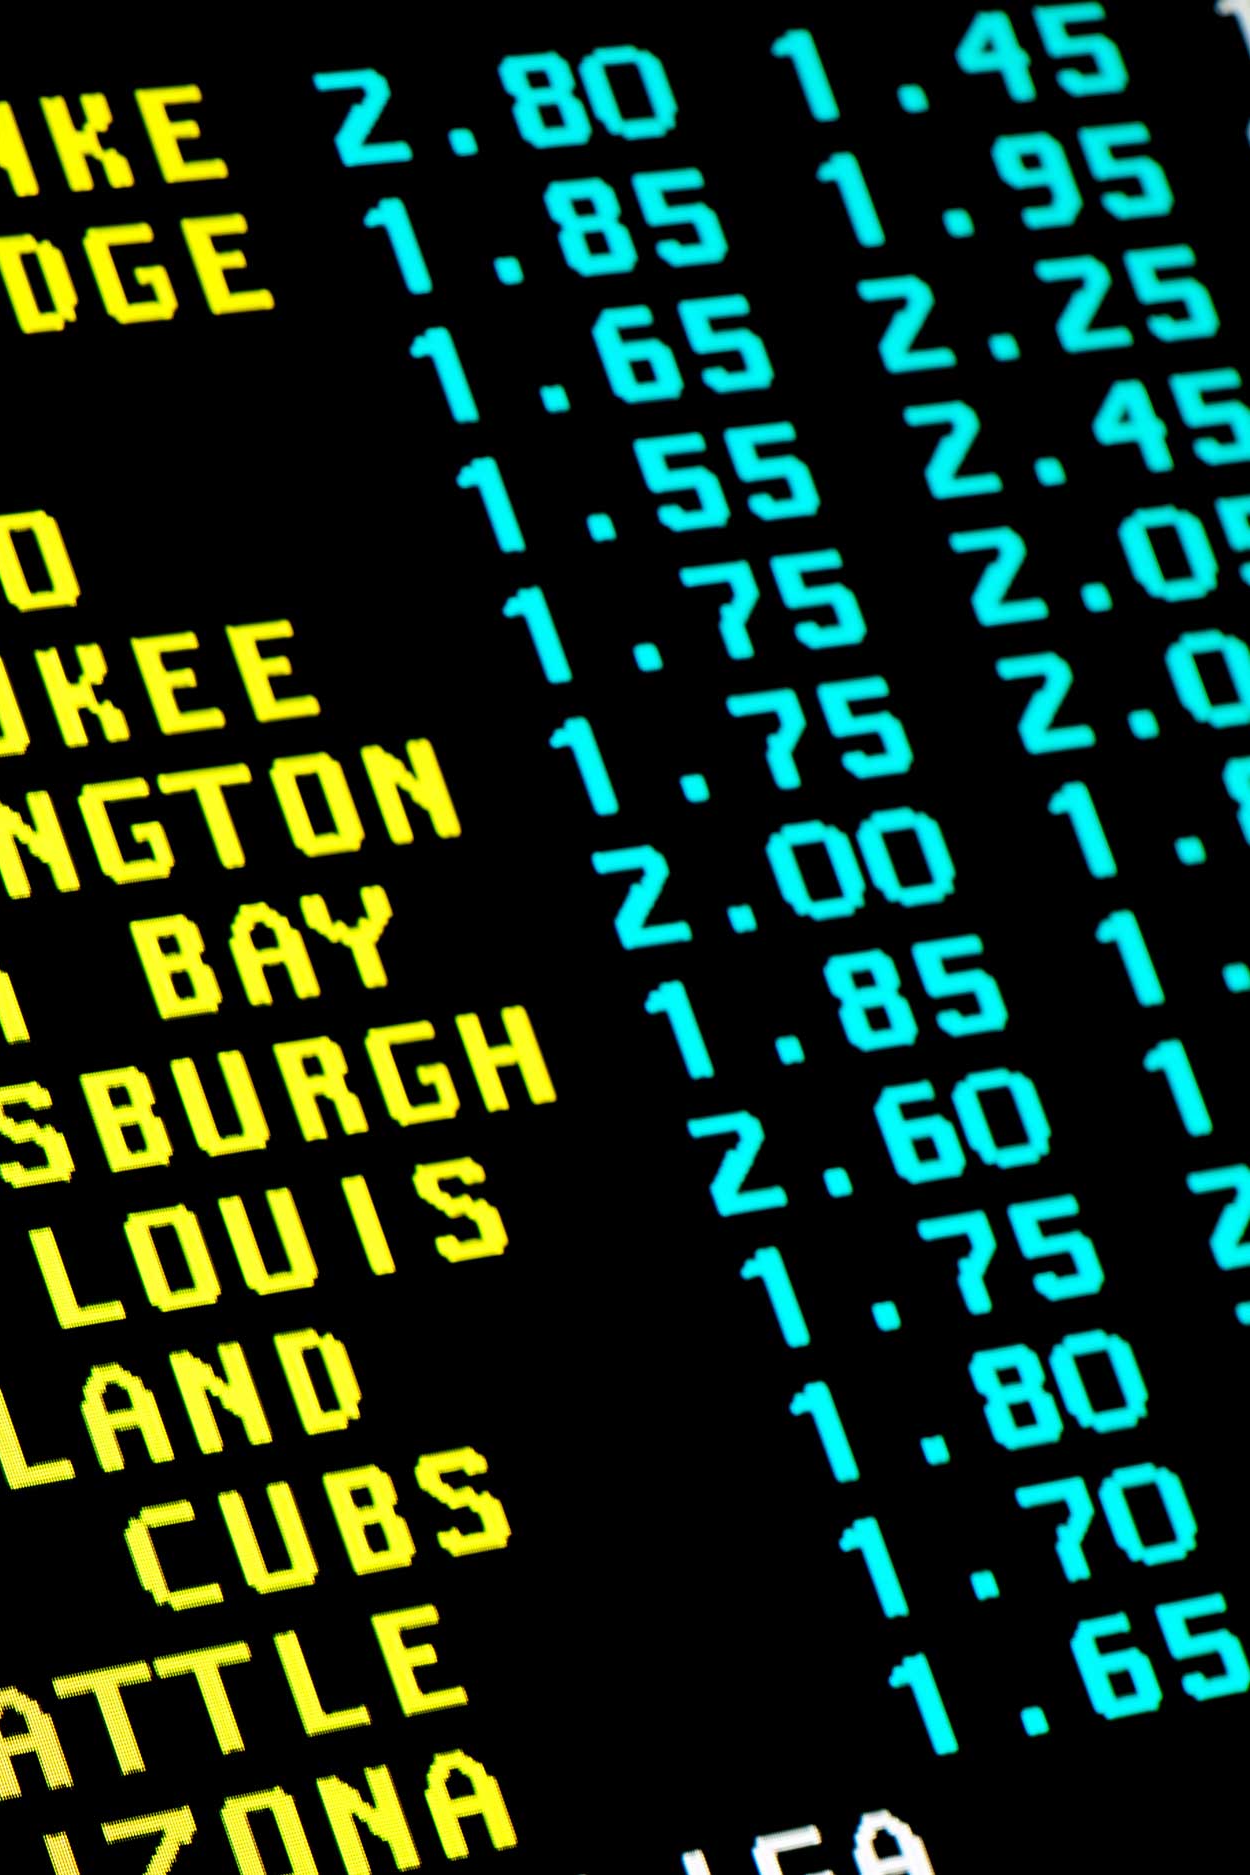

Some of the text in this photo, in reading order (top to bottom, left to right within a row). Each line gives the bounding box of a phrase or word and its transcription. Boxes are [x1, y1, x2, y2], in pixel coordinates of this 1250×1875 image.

[313, 46, 677, 167] 2.80
[772, 0, 1128, 121] 1.45
[364, 168, 728, 294] 1.85
[817, 123, 1173, 246] 1.95
[410, 295, 773, 422] 1.65
[857, 245, 1219, 373] 2.25
[457, 422, 820, 552] 1.55
[904, 369, 1250, 499] 2.45
[503, 549, 866, 683] 1.75
[550, 677, 913, 816] 1.75
[130, 885, 392, 1019] BAY
[592, 807, 955, 950] 2.00
[1049, 757, 1250, 878] 1.
[644, 935, 1008, 1079] 1.85
[29, 1157, 508, 1329] LOUIS
[687, 1069, 1051, 1216] 2.60
[740, 1195, 1104, 1348] 1.75
[124, 1447, 511, 1611] CUBS
[790, 1330, 1148, 1482] 1.80
[839, 1463, 1197, 1618] 1.70
[889, 1593, 1250, 1755] 1.65
